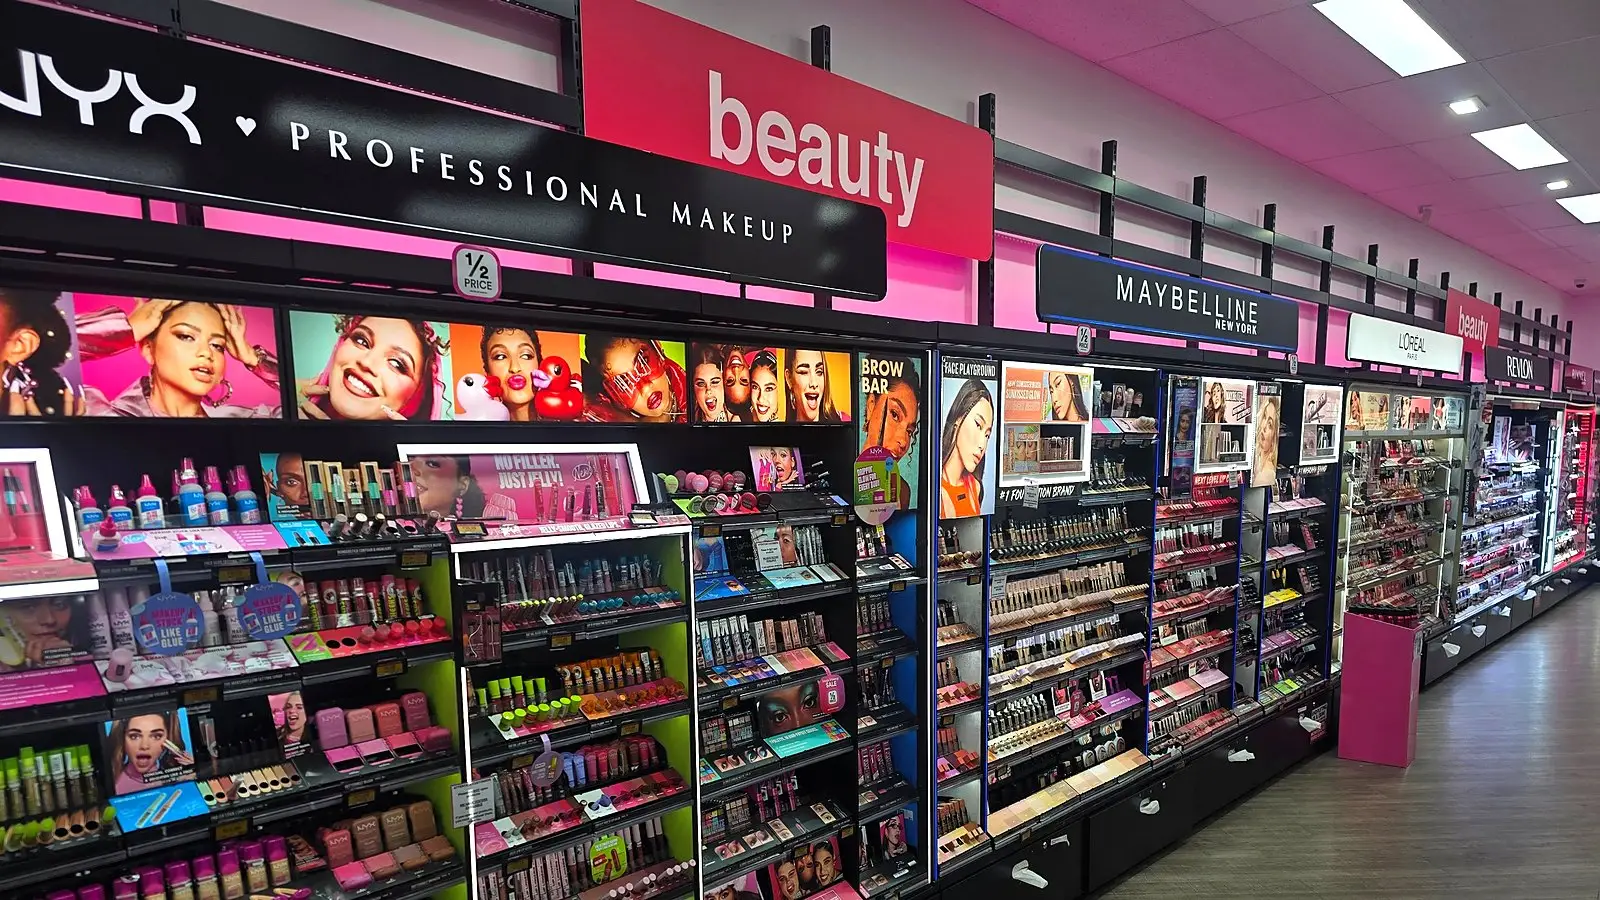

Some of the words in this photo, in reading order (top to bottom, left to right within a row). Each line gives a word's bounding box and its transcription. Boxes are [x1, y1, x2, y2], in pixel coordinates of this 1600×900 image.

[708, 70, 924, 227] beauty
[290, 121, 647, 218] PROFESSIONAL
[672, 201, 794, 245] MAKEUP
[464, 278, 493, 290] PRICE
[1116, 274, 1259, 324] MAYBELLINE
[1215, 318, 1234, 331] NEW
[1234, 321, 1258, 335] YORK
[1458, 306, 1489, 349] beauty
[1398, 332, 1426, 353] L'ORÉAL
[861, 358, 904, 378] BROW
[944, 361, 958, 376] FACE
[958, 362, 996, 378] PLAYGROUND
[1506, 355, 1534, 380] REVLON
[861, 377, 889, 394] BAR
[494, 454, 514, 470] NO
[513, 454, 560, 470] FILLER.
[499, 471, 527, 489] JUST
[527, 470, 564, 488] JELLY!
[1194, 474, 1206, 485] NEXT
[1206, 474, 1219, 485] LEVEL
[999, 490, 1010, 502] #1
[1010, 486, 1051, 502] FOUTION
[1051, 485, 1076, 498] BRAND
[262, 613, 282, 625] LIKE
[160, 627, 182, 638] LIKE
[263, 623, 285, 634] GLUE
[161, 637, 184, 648] GLUE
[825, 680, 837, 688] SALE
[407, 697, 425, 705] NYX
[380, 709, 397, 717] NYX
[356, 821, 376, 831] NYX
[385, 814, 404, 823] NYX
[329, 836, 348, 846] NYX
